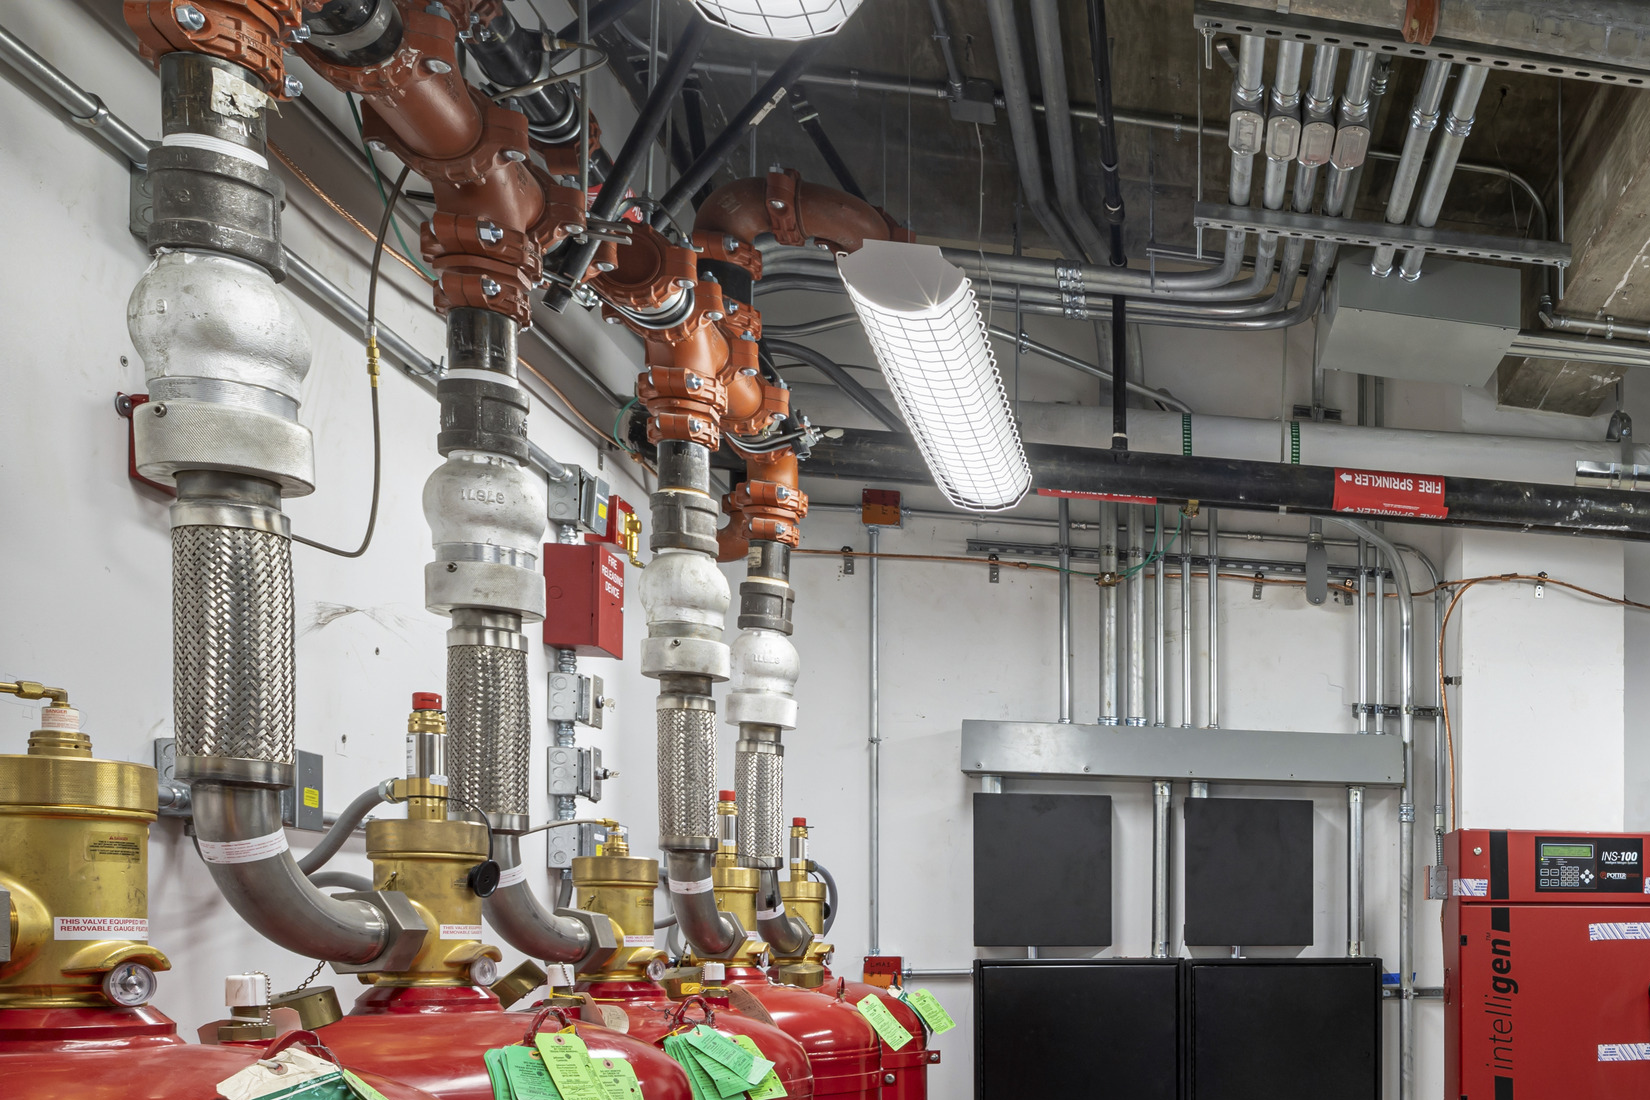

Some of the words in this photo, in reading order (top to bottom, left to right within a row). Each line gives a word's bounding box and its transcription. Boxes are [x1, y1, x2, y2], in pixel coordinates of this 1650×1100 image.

[1355, 474, 1412, 492] SPRINKLER
[1419, 480, 1441, 494] FIRE
[608, 555, 617, 570] FIRE
[602, 565, 623, 587] RELEASING
[605, 581, 619, 599] DEVICE
[1601, 852, 1638, 862] INS-100
[1485, 938, 1518, 1070] intelligen
